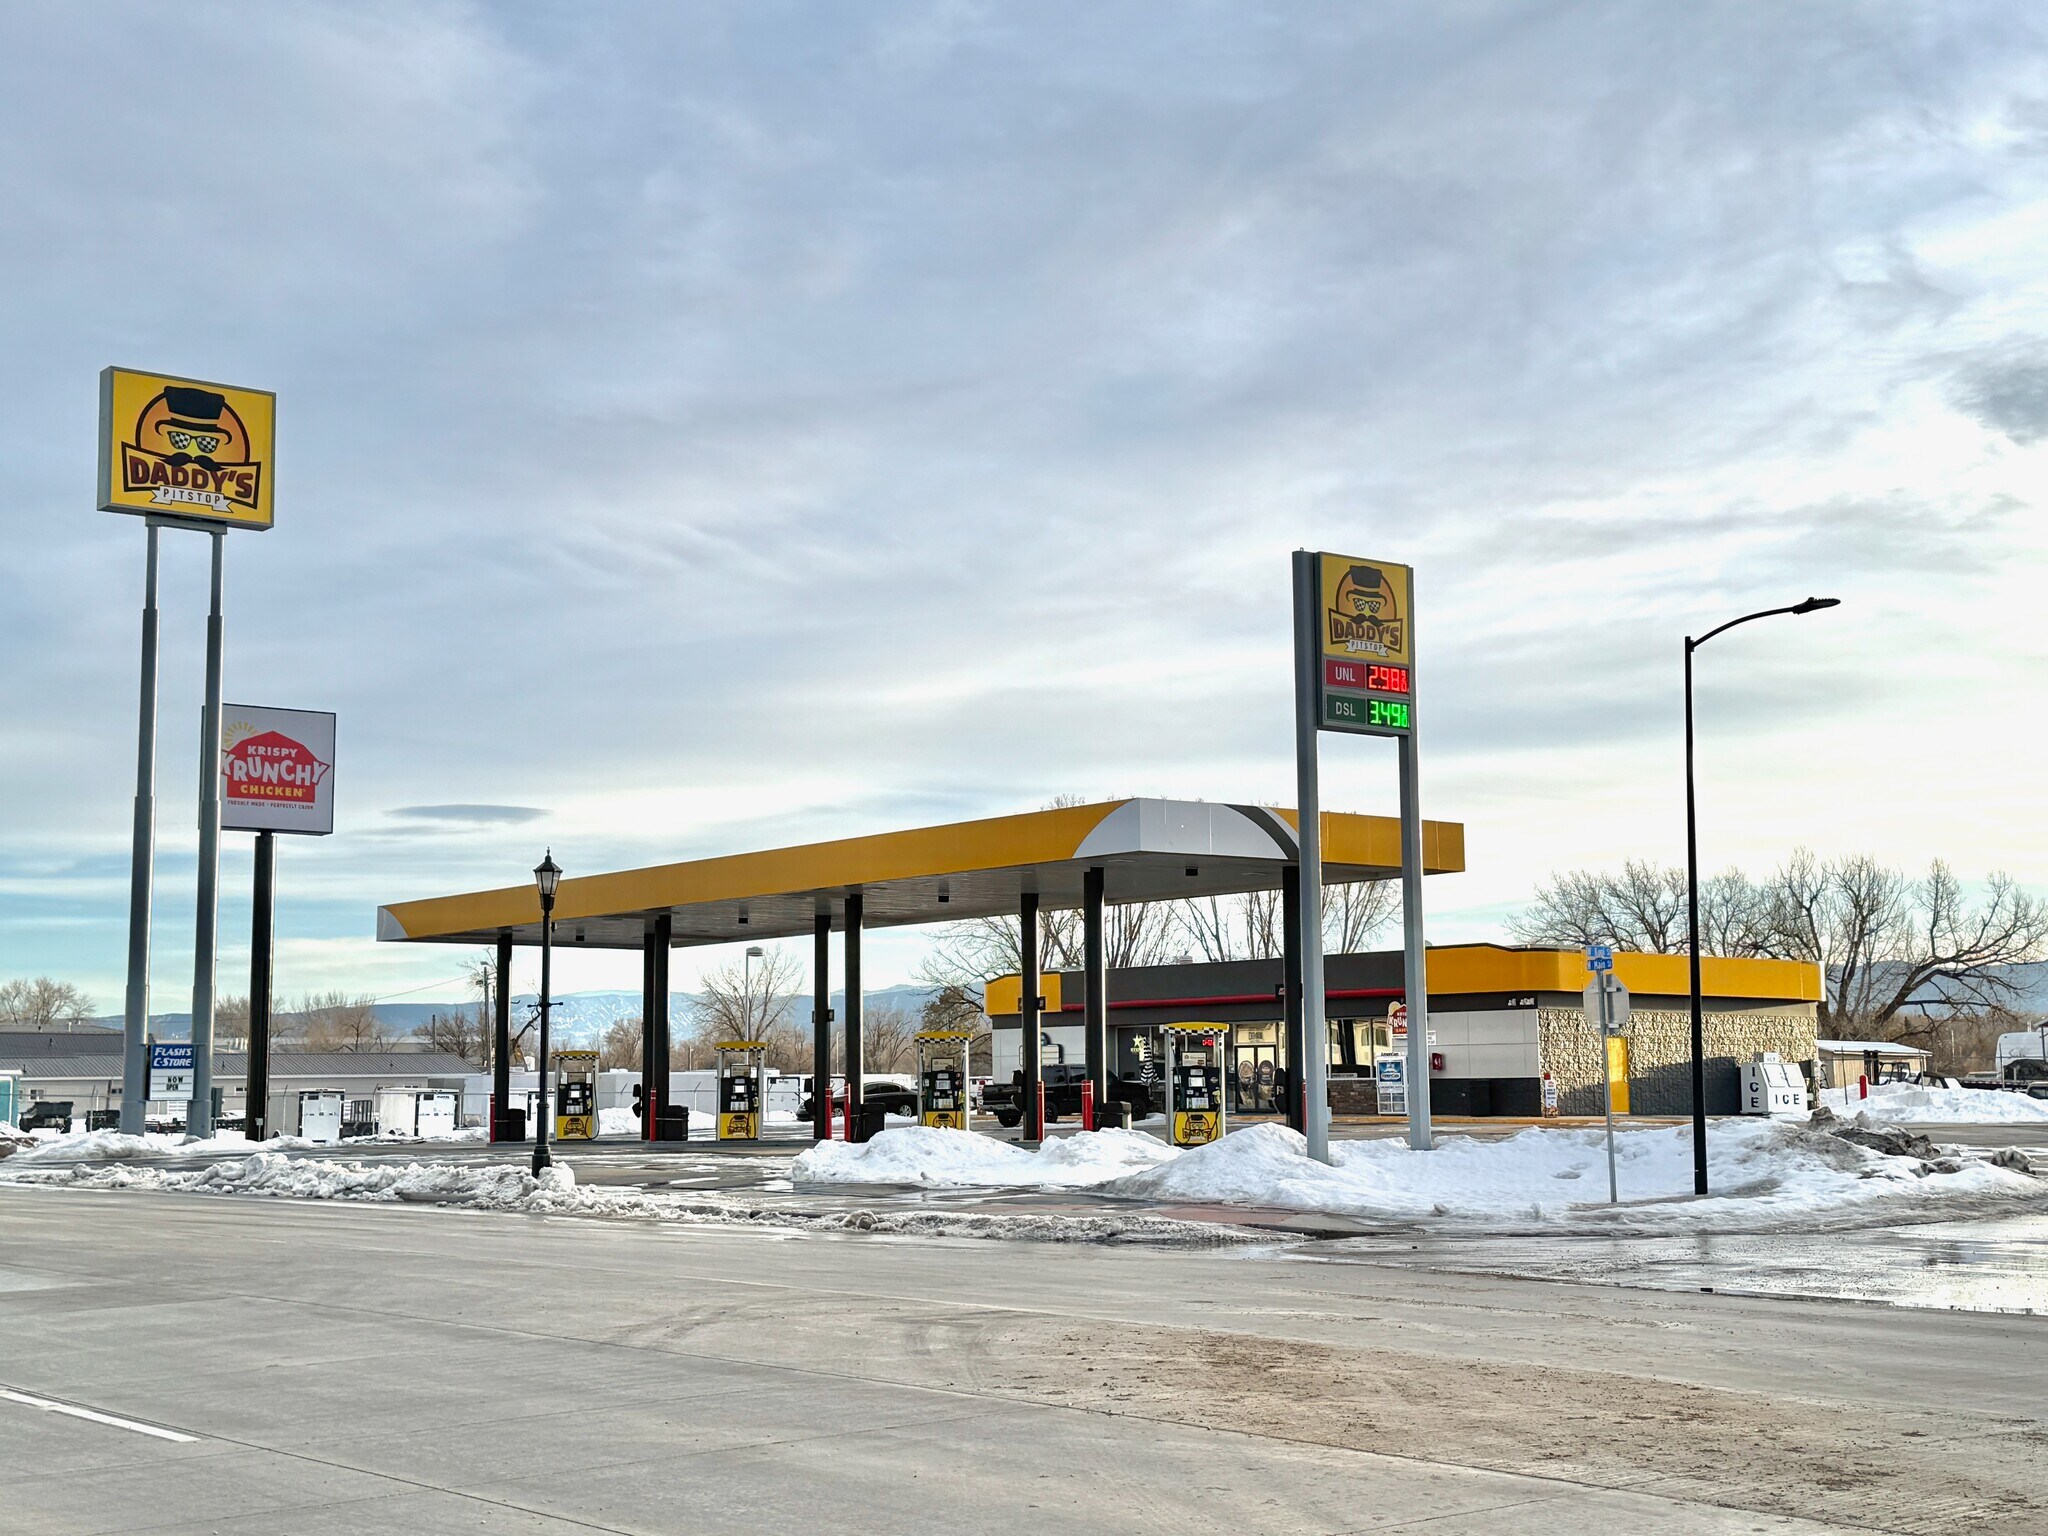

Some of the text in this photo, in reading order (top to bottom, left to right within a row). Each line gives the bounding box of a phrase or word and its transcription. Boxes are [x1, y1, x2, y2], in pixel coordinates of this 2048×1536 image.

[129, 455, 253, 498] DADDY'S
[163, 488, 221, 504] PITSTOP
[1333, 618, 1400, 646] DADDY'S
[1351, 640, 1383, 652] PITSTOP
[1335, 666, 1356, 682] UNL
[1335, 702, 1356, 717] DSL
[247, 745, 298, 758] KRISPY
[220, 751, 327, 786] KRUNCHY
[240, 784, 303, 797] CHICKEN
[1749, 1066, 1759, 1108] ICE
[1775, 1093, 1801, 1105] ICE
